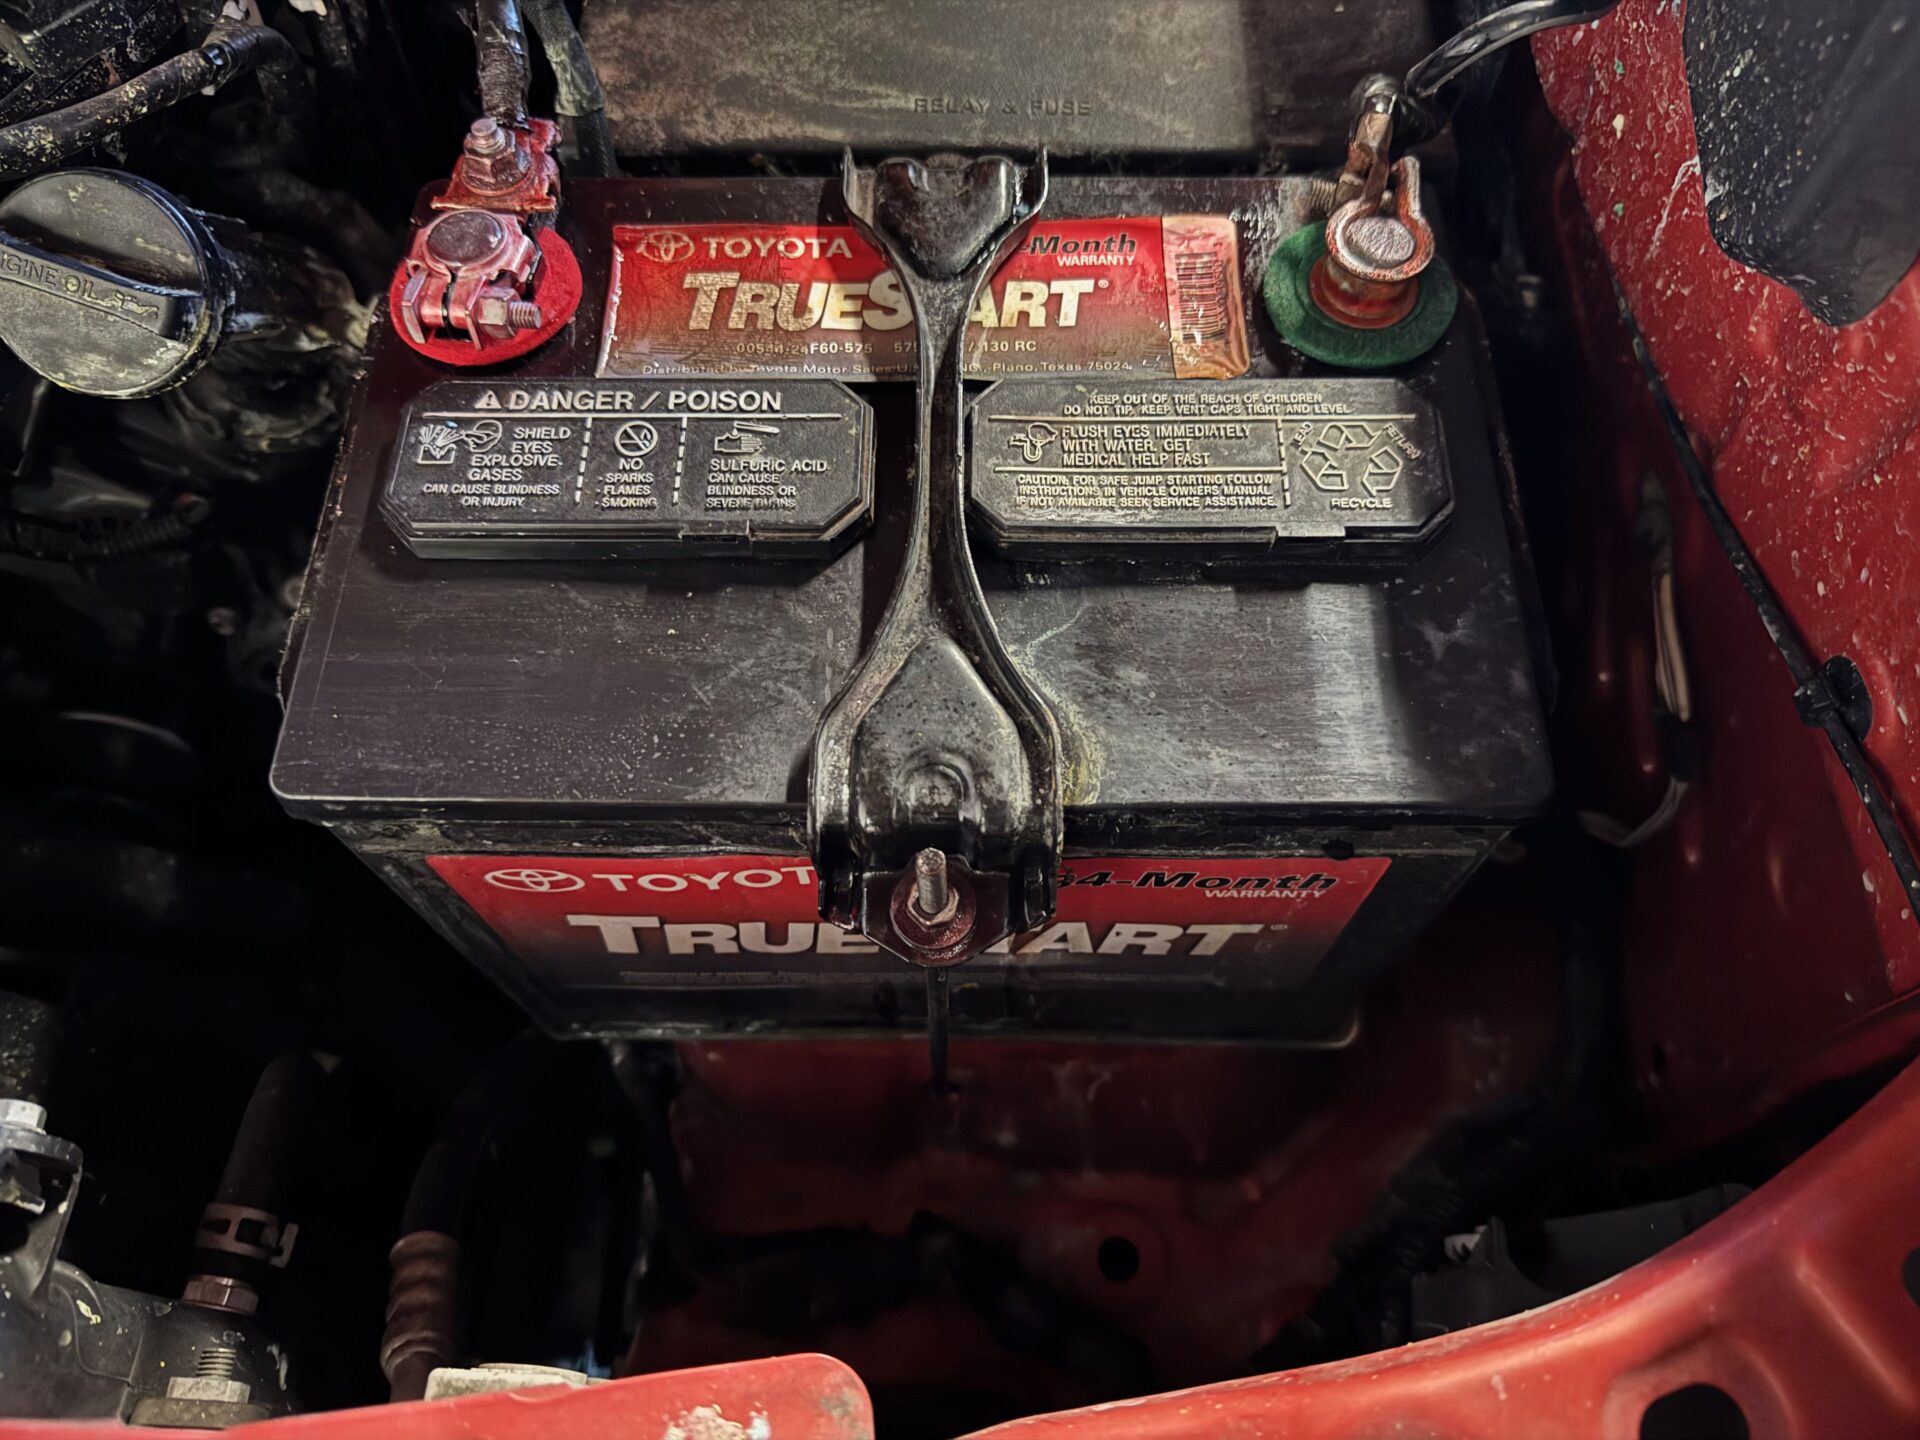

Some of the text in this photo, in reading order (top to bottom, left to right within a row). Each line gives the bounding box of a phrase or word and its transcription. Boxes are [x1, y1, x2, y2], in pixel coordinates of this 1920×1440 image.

[914, 98, 1091, 117] RELAY & FUSE
[703, 237, 853, 259] TOYOTA
[1057, 255, 1135, 266] WARRANTY
[65, 274, 98, 300] OIL
[981, 341, 1009, 352] 130
[1015, 340, 1037, 352] RC
[749, 364, 798, 374] Toyota
[803, 364, 848, 374] Motor
[993, 361, 1038, 374] Plano,
[1040, 361, 1082, 372] Texas
[509, 390, 783, 410] DANGER / POISON
[1090, 394, 1322, 404] KEEP OUT OF THE REACH OF CHILDREN
[1064, 404, 1080, 415] DO
[1086, 404, 1109, 415] NOT
[1141, 404, 1171, 415] KEEP
[1176, 404, 1205, 415] VENT
[1210, 404, 1242, 415] CAPS
[1246, 404, 1280, 415] TIGHT
[1286, 404, 1312, 415] AND
[513, 427, 571, 440] SHIELD
[1062, 424, 1251, 437] FLUSH EYES IMMEDIATELY
[1062, 439, 1192, 452] WITH WATER. GET
[1383, 422, 1421, 459] RETURN
[511, 441, 553, 453] EYES
[619, 457, 644, 471] NO
[710, 458, 786, 472] SULFURIC
[1063, 453, 1210, 466] MEDICAL HELP FAST
[467, 468, 523, 481] GASES
[708, 473, 780, 483] CAN CAUSE
[1073, 474, 1095, 485] FOR
[1100, 474, 1129, 485] SAFE
[1131, 474, 1163, 485] JUMP
[1167, 474, 1222, 485] STARTING
[1226, 474, 1273, 485] FOLLOW
[423, 484, 560, 495] CAN CAUSE BLINDNESS
[707, 485, 797, 496] BLINDNESS OR
[1020, 485, 1272, 496] INSTRUCTIONS IN VEHICLE OWNERS MANUAL
[461, 496, 525, 506] OR INJURY
[1016, 496, 1027, 507] IF
[1030, 496, 1054, 507] NOT
[1058, 496, 1116, 507] AVAILABLE
[1120, 496, 1149, 507] SEEK
[1153, 496, 1200, 507] SERVICE
[1331, 497, 1393, 509] RECYCLE
[592, 865, 815, 892] TOYOT
[1204, 889, 1327, 898] WARRANTY
